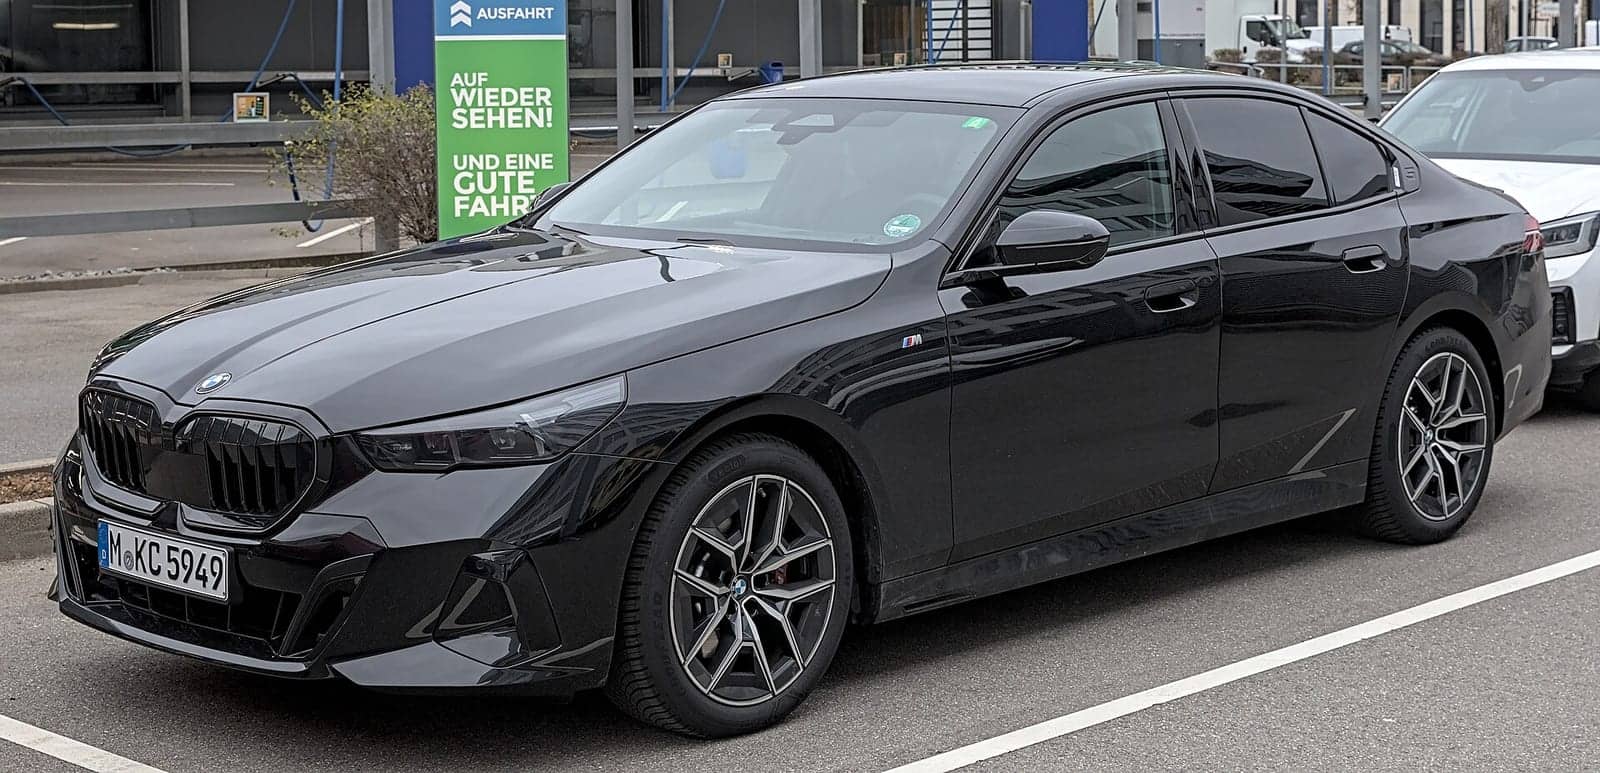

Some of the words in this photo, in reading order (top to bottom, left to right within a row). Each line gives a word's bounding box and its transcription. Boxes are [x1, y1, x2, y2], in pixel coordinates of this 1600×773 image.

[476, 7, 554, 20] AUSFAHRT
[450, 72, 489, 87] AUF
[450, 87, 552, 107] WIEDER
[451, 107, 553, 129] SEHEN!
[453, 154, 500, 171] UND
[505, 153, 554, 170] EINE
[453, 171, 535, 195] GUTE
[454, 195, 537, 217] FAHR
[109, 530, 121, 567] M
[135, 536, 161, 577] KC
[167, 544, 224, 591] 5949
